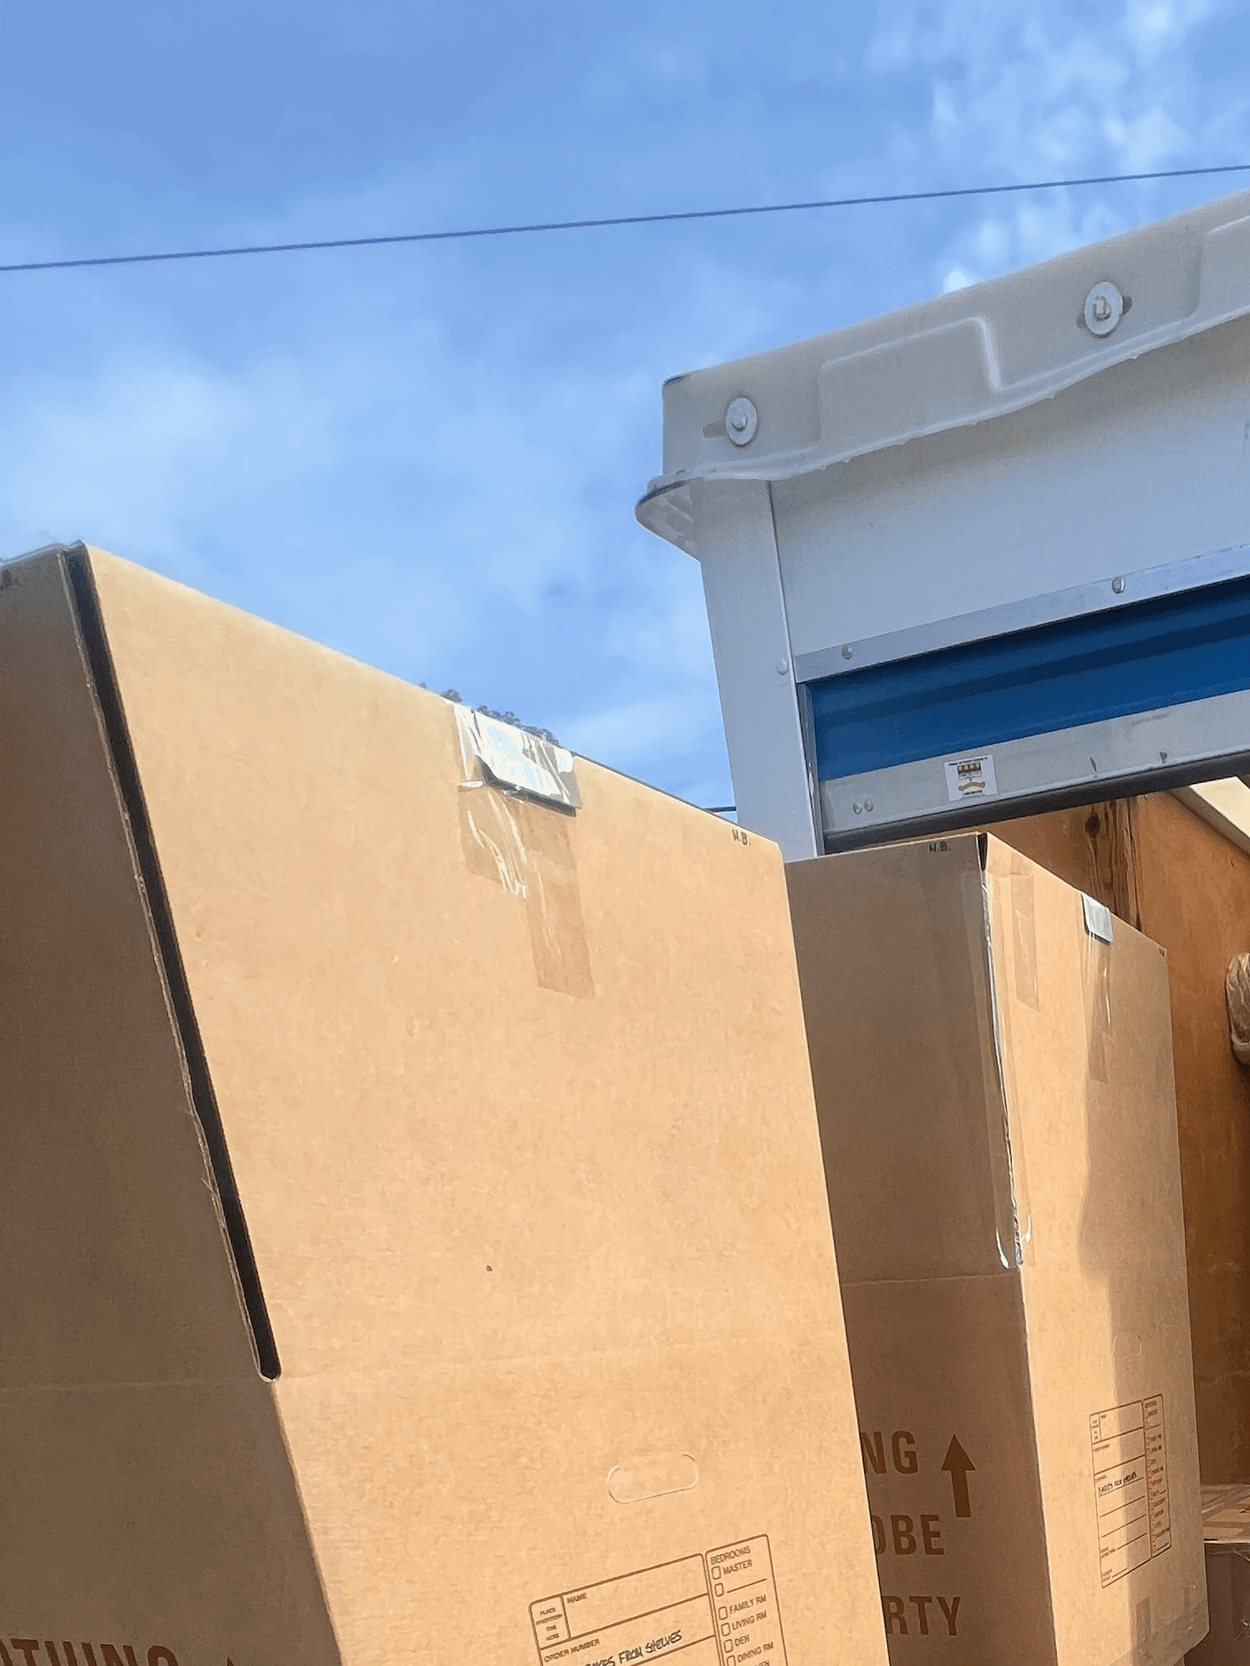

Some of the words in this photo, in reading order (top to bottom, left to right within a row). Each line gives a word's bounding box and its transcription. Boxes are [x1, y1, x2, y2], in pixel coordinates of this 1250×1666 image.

[710, 1545, 751, 1565] BEDROOMS
[722, 1559, 753, 1575] MASTER
[729, 1598, 755, 1615] FAMILY
[732, 1615, 755, 1631] LIVING
[618, 1647, 644, 1665] FROM
[645, 1629, 683, 1654] SHELVES
[734, 1634, 750, 1647] DEN
[544, 1650, 570, 1663] ORDER
[737, 1646, 762, 1663] DINING
